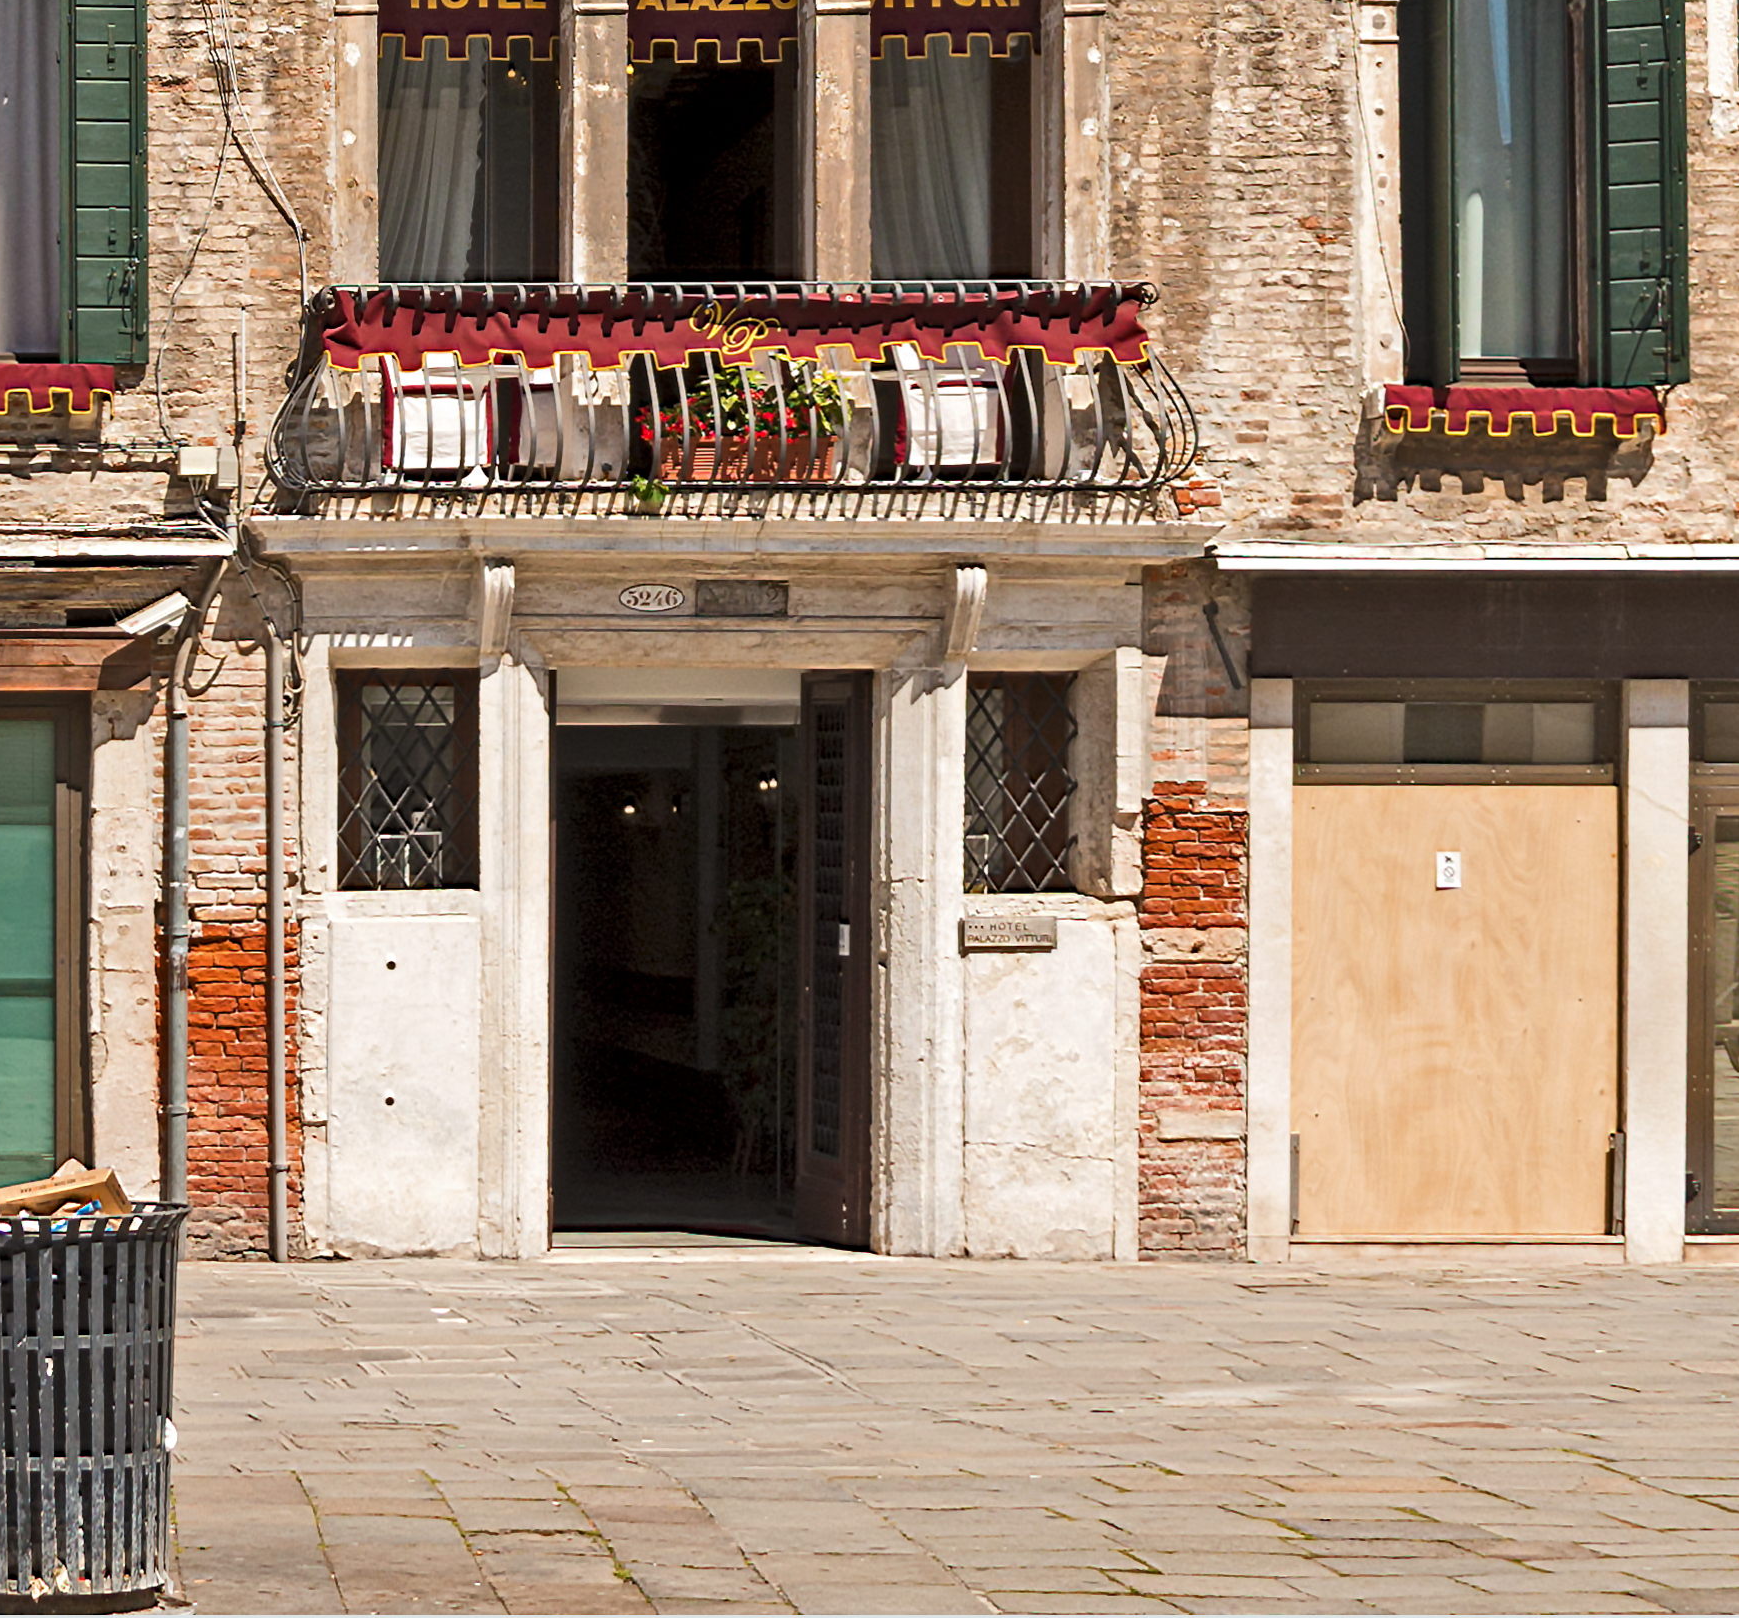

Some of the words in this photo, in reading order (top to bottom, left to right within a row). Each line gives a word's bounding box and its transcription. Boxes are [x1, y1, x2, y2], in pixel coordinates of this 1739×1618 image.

[626, 590, 678, 607] 5246
[990, 922, 1029, 931] HOTEL
[967, 934, 1011, 943] PALAZZO
[1015, 934, 1052, 943] VITTURI
